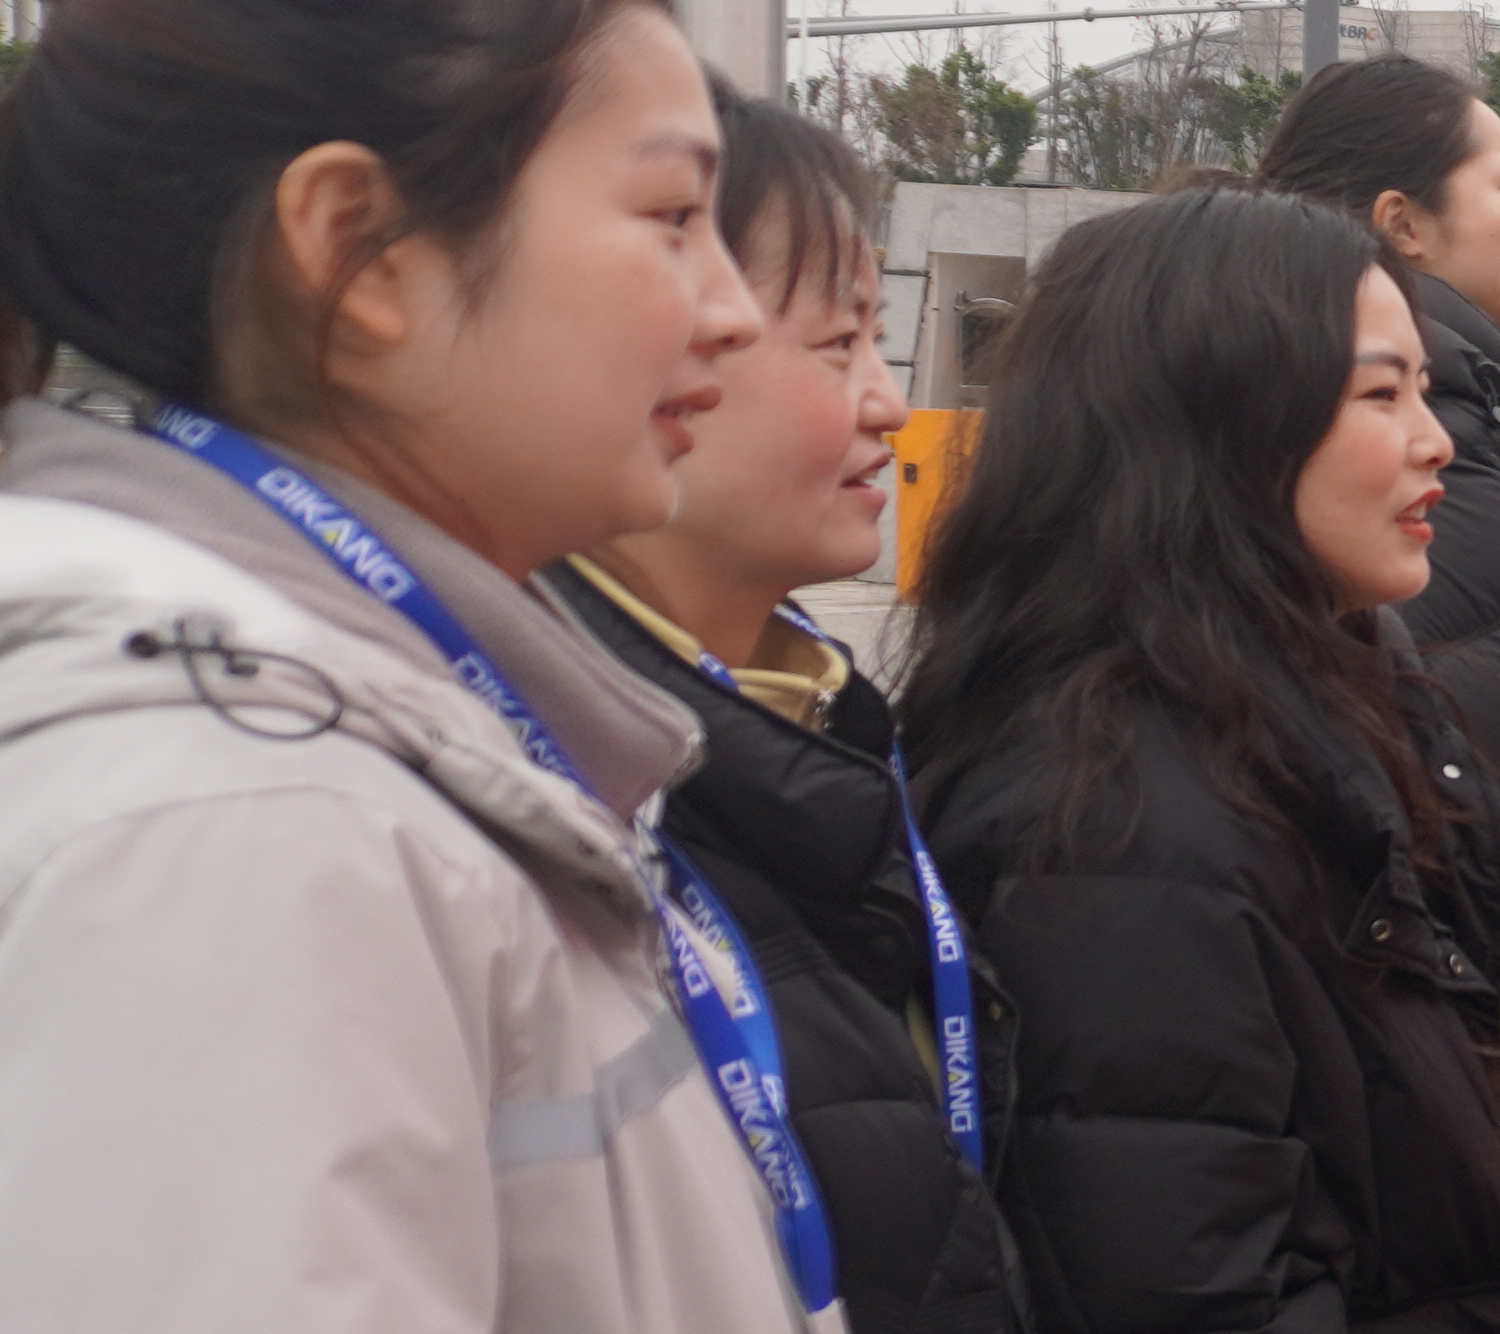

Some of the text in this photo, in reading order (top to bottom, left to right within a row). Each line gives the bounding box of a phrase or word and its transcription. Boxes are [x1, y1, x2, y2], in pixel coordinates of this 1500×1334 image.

[255, 467, 418, 601] DIKANG
[914, 850, 961, 964] DIKANG
[944, 1015, 974, 1134] DIKANG
